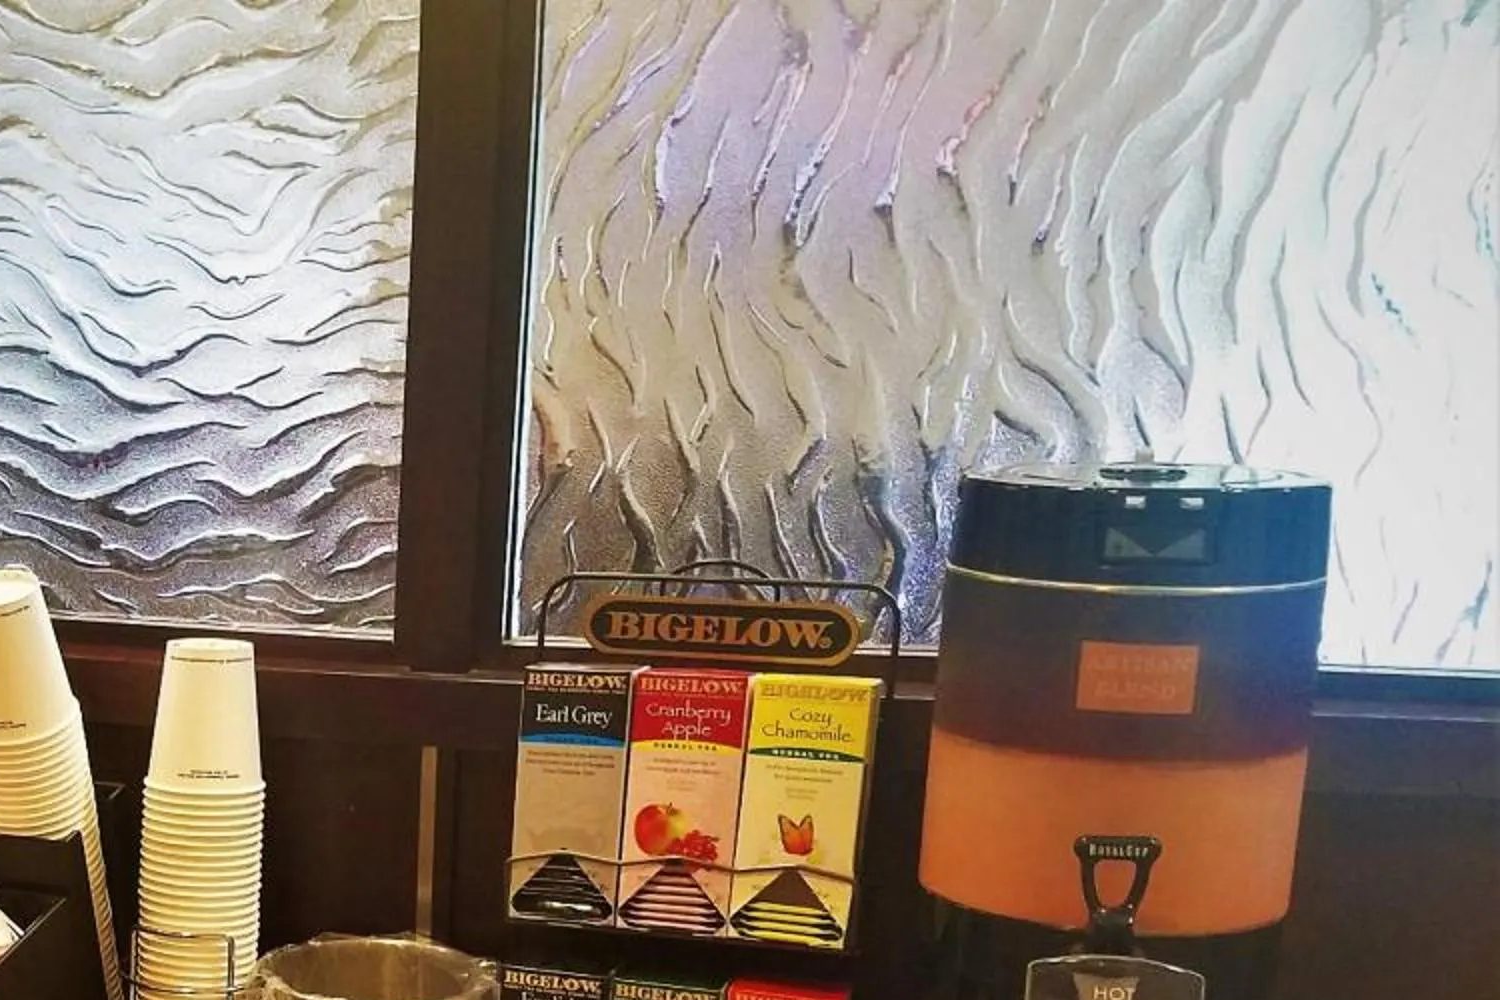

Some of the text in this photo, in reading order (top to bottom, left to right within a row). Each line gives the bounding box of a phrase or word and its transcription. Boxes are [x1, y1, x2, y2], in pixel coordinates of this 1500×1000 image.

[604, 610, 833, 650] BIGELOW
[528, 671, 627, 689] BIGELOW
[640, 677, 744, 693] BIGELOW
[535, 703, 613, 729] Earl Grey
[644, 699, 732, 727] Cranberry
[789, 707, 833, 729] Cozy
[661, 716, 713, 741] Apple
[761, 719, 852, 743] Chamomile
[504, 970, 602, 994] BIGELOW
